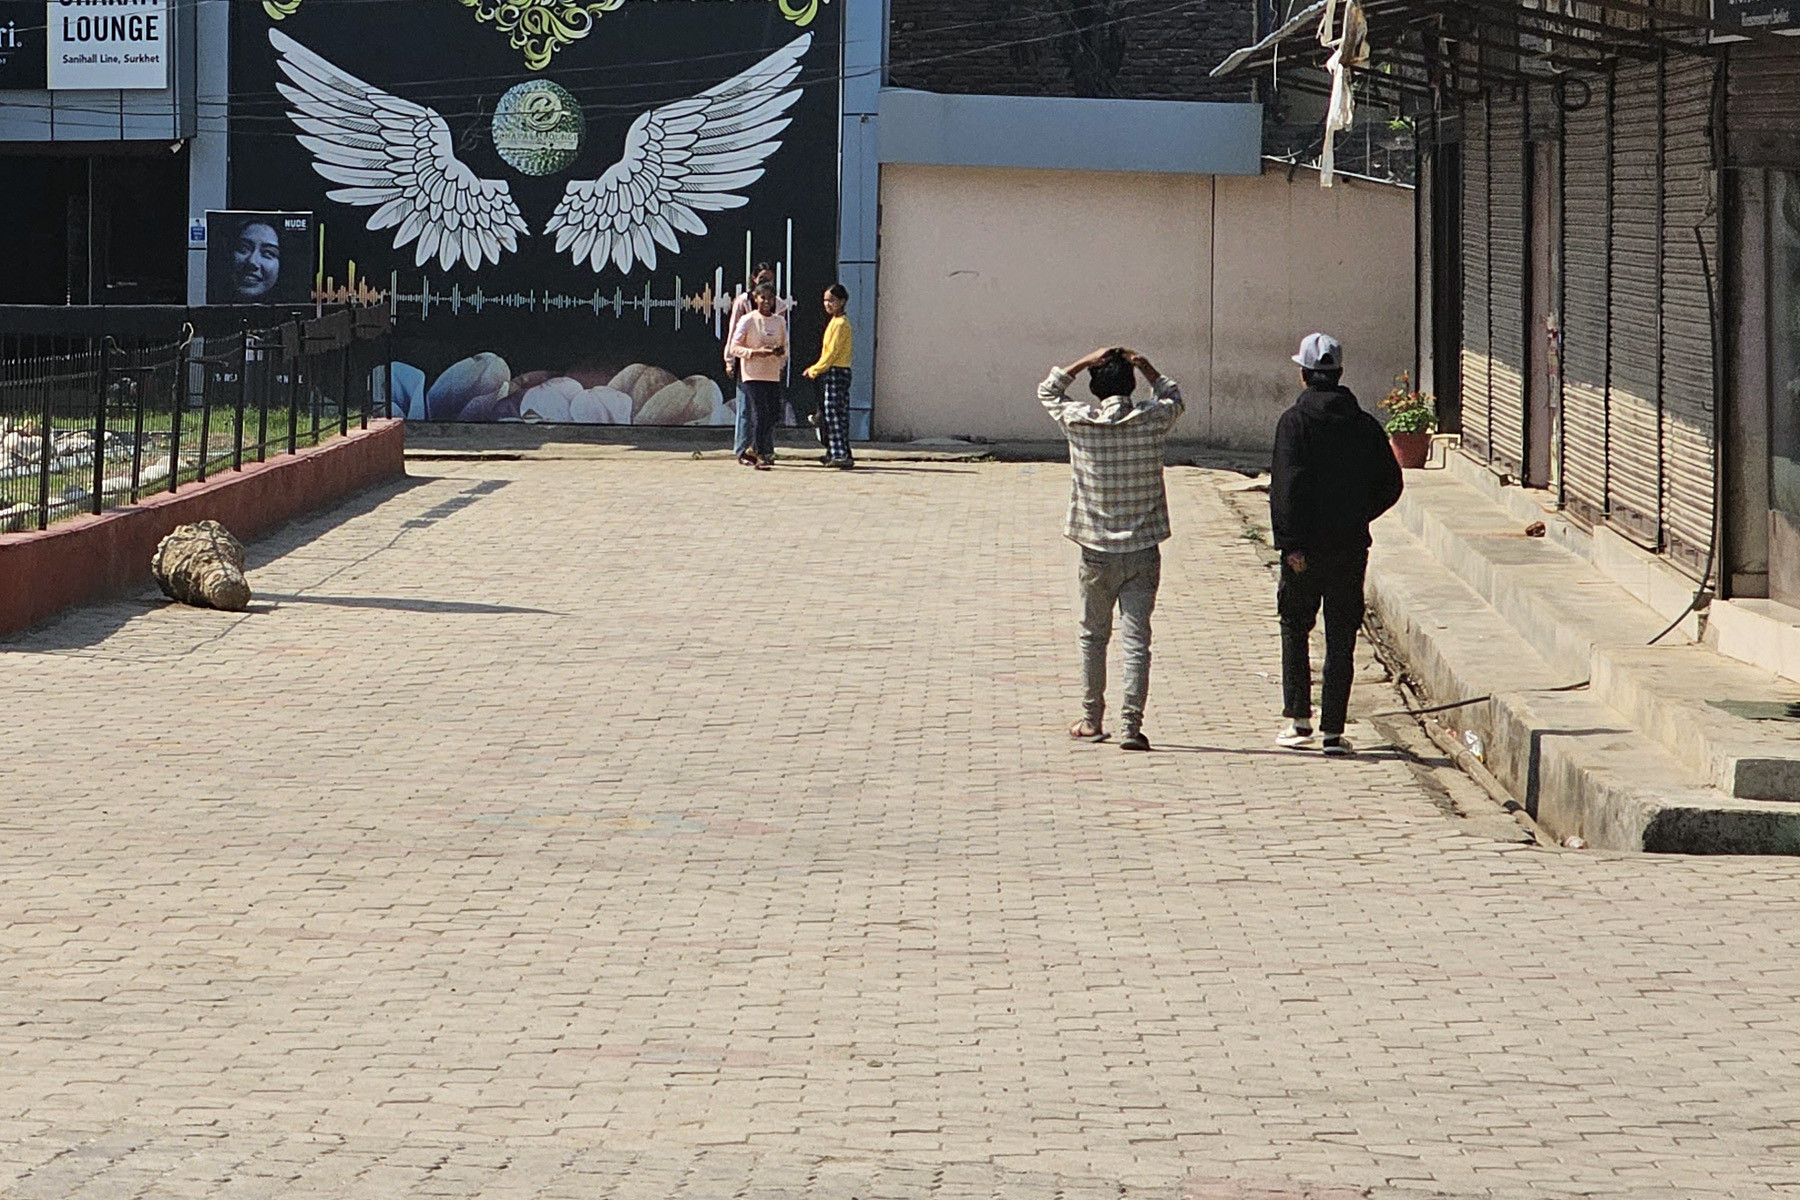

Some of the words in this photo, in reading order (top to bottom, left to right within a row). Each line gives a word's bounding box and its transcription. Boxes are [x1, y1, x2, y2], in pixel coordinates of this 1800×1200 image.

[63, 15, 159, 41] LOUNGE
[62, 54, 98, 64] Sanihall
[100, 54, 121, 65] Line,
[124, 53, 160, 64] Surkhet
[284, 218, 307, 228] NUDE
